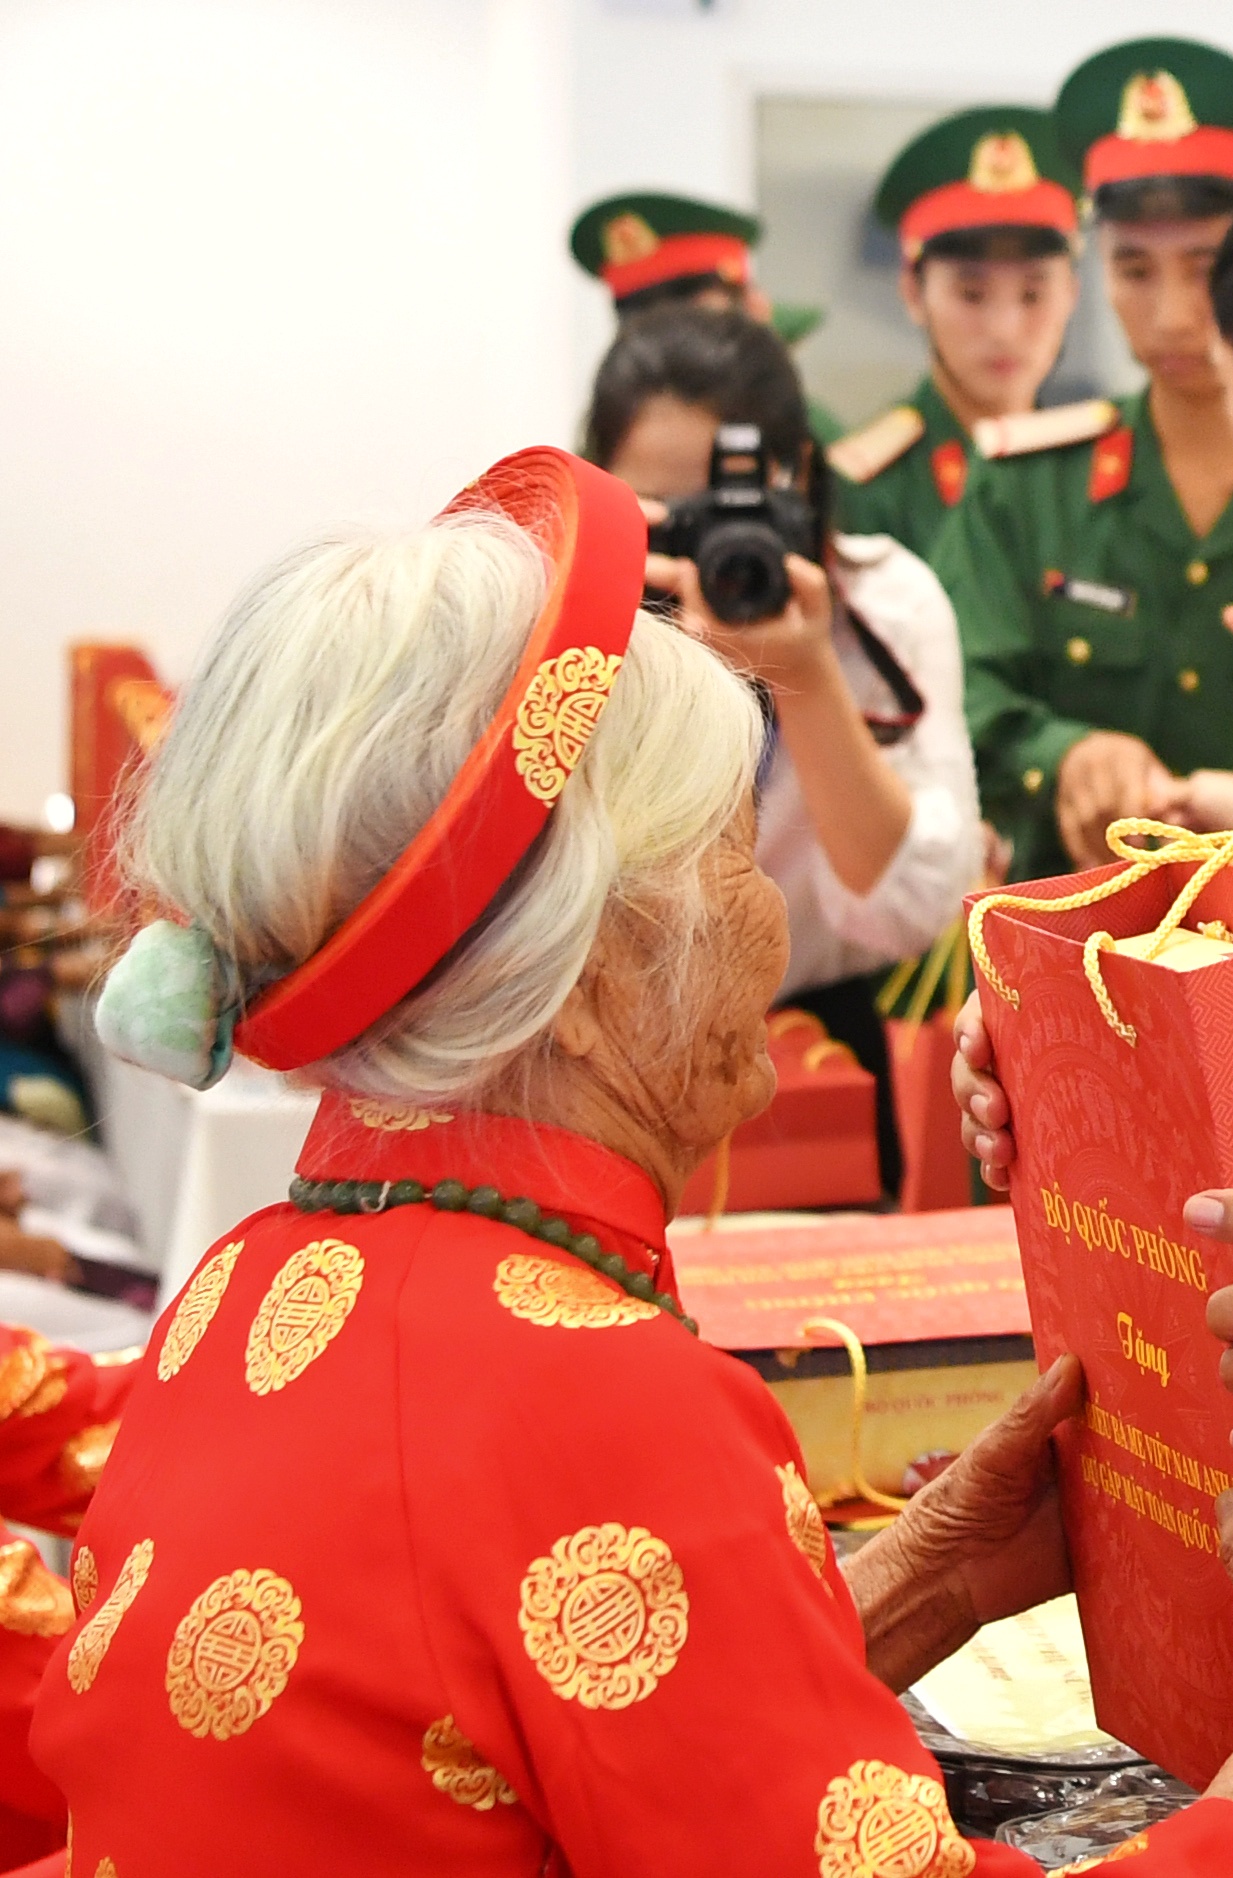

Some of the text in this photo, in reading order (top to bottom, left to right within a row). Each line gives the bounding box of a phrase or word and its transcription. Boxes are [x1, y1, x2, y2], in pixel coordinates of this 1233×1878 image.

[1041, 1181, 1208, 1292] BỘ QUỐC PHÒNG
[1117, 1311, 1171, 1388] Tặng
[1110, 1409, 1129, 1450] BÀ
[1126, 1424, 1145, 1467] MẸ
[1144, 1431, 1171, 1479] VIỆT
[1171, 1448, 1202, 1491] NAM
[1099, 1460, 1121, 1504] GẶP
[1145, 1490, 1177, 1534] TOÀN
[1177, 1508, 1213, 1554] QUỐC
